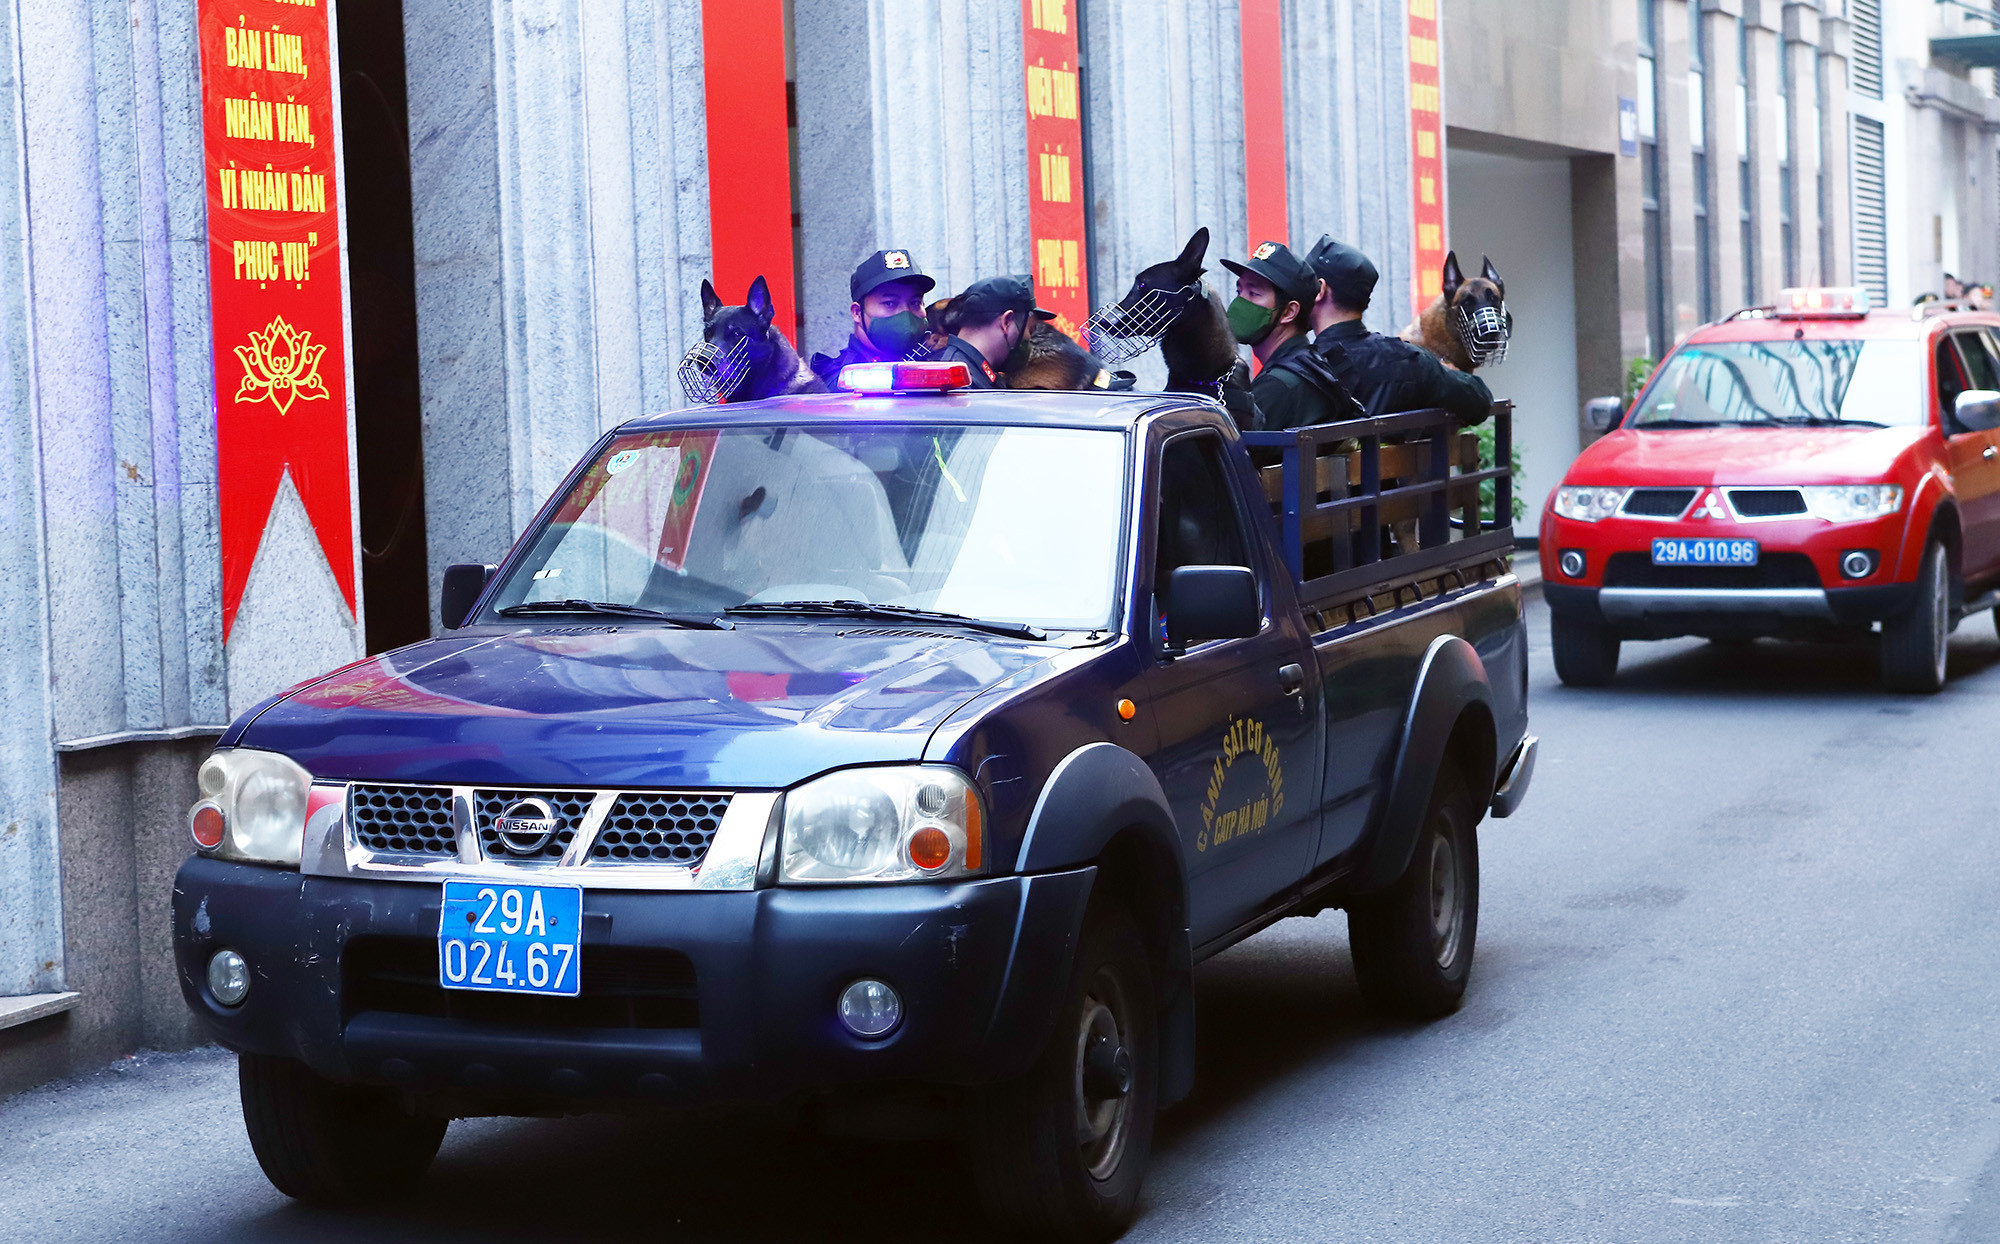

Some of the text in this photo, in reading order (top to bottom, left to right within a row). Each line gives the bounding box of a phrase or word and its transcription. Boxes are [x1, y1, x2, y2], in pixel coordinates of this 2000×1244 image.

[225, 14, 308, 80] BẢN LĨNH,
[224, 91, 315, 149] NHÂN VĂN,
[219, 160, 326, 213] VÌ NHÂN DÂN
[233, 240, 279, 290] PHỤC
[1223, 713, 1244, 768] SÁT
[500, 819, 549, 831] NISSAN
[1213, 792, 1269, 847] CATP HÀ NỘI
[474, 888, 546, 937] 29A
[445, 938, 574, 989] 024.67
